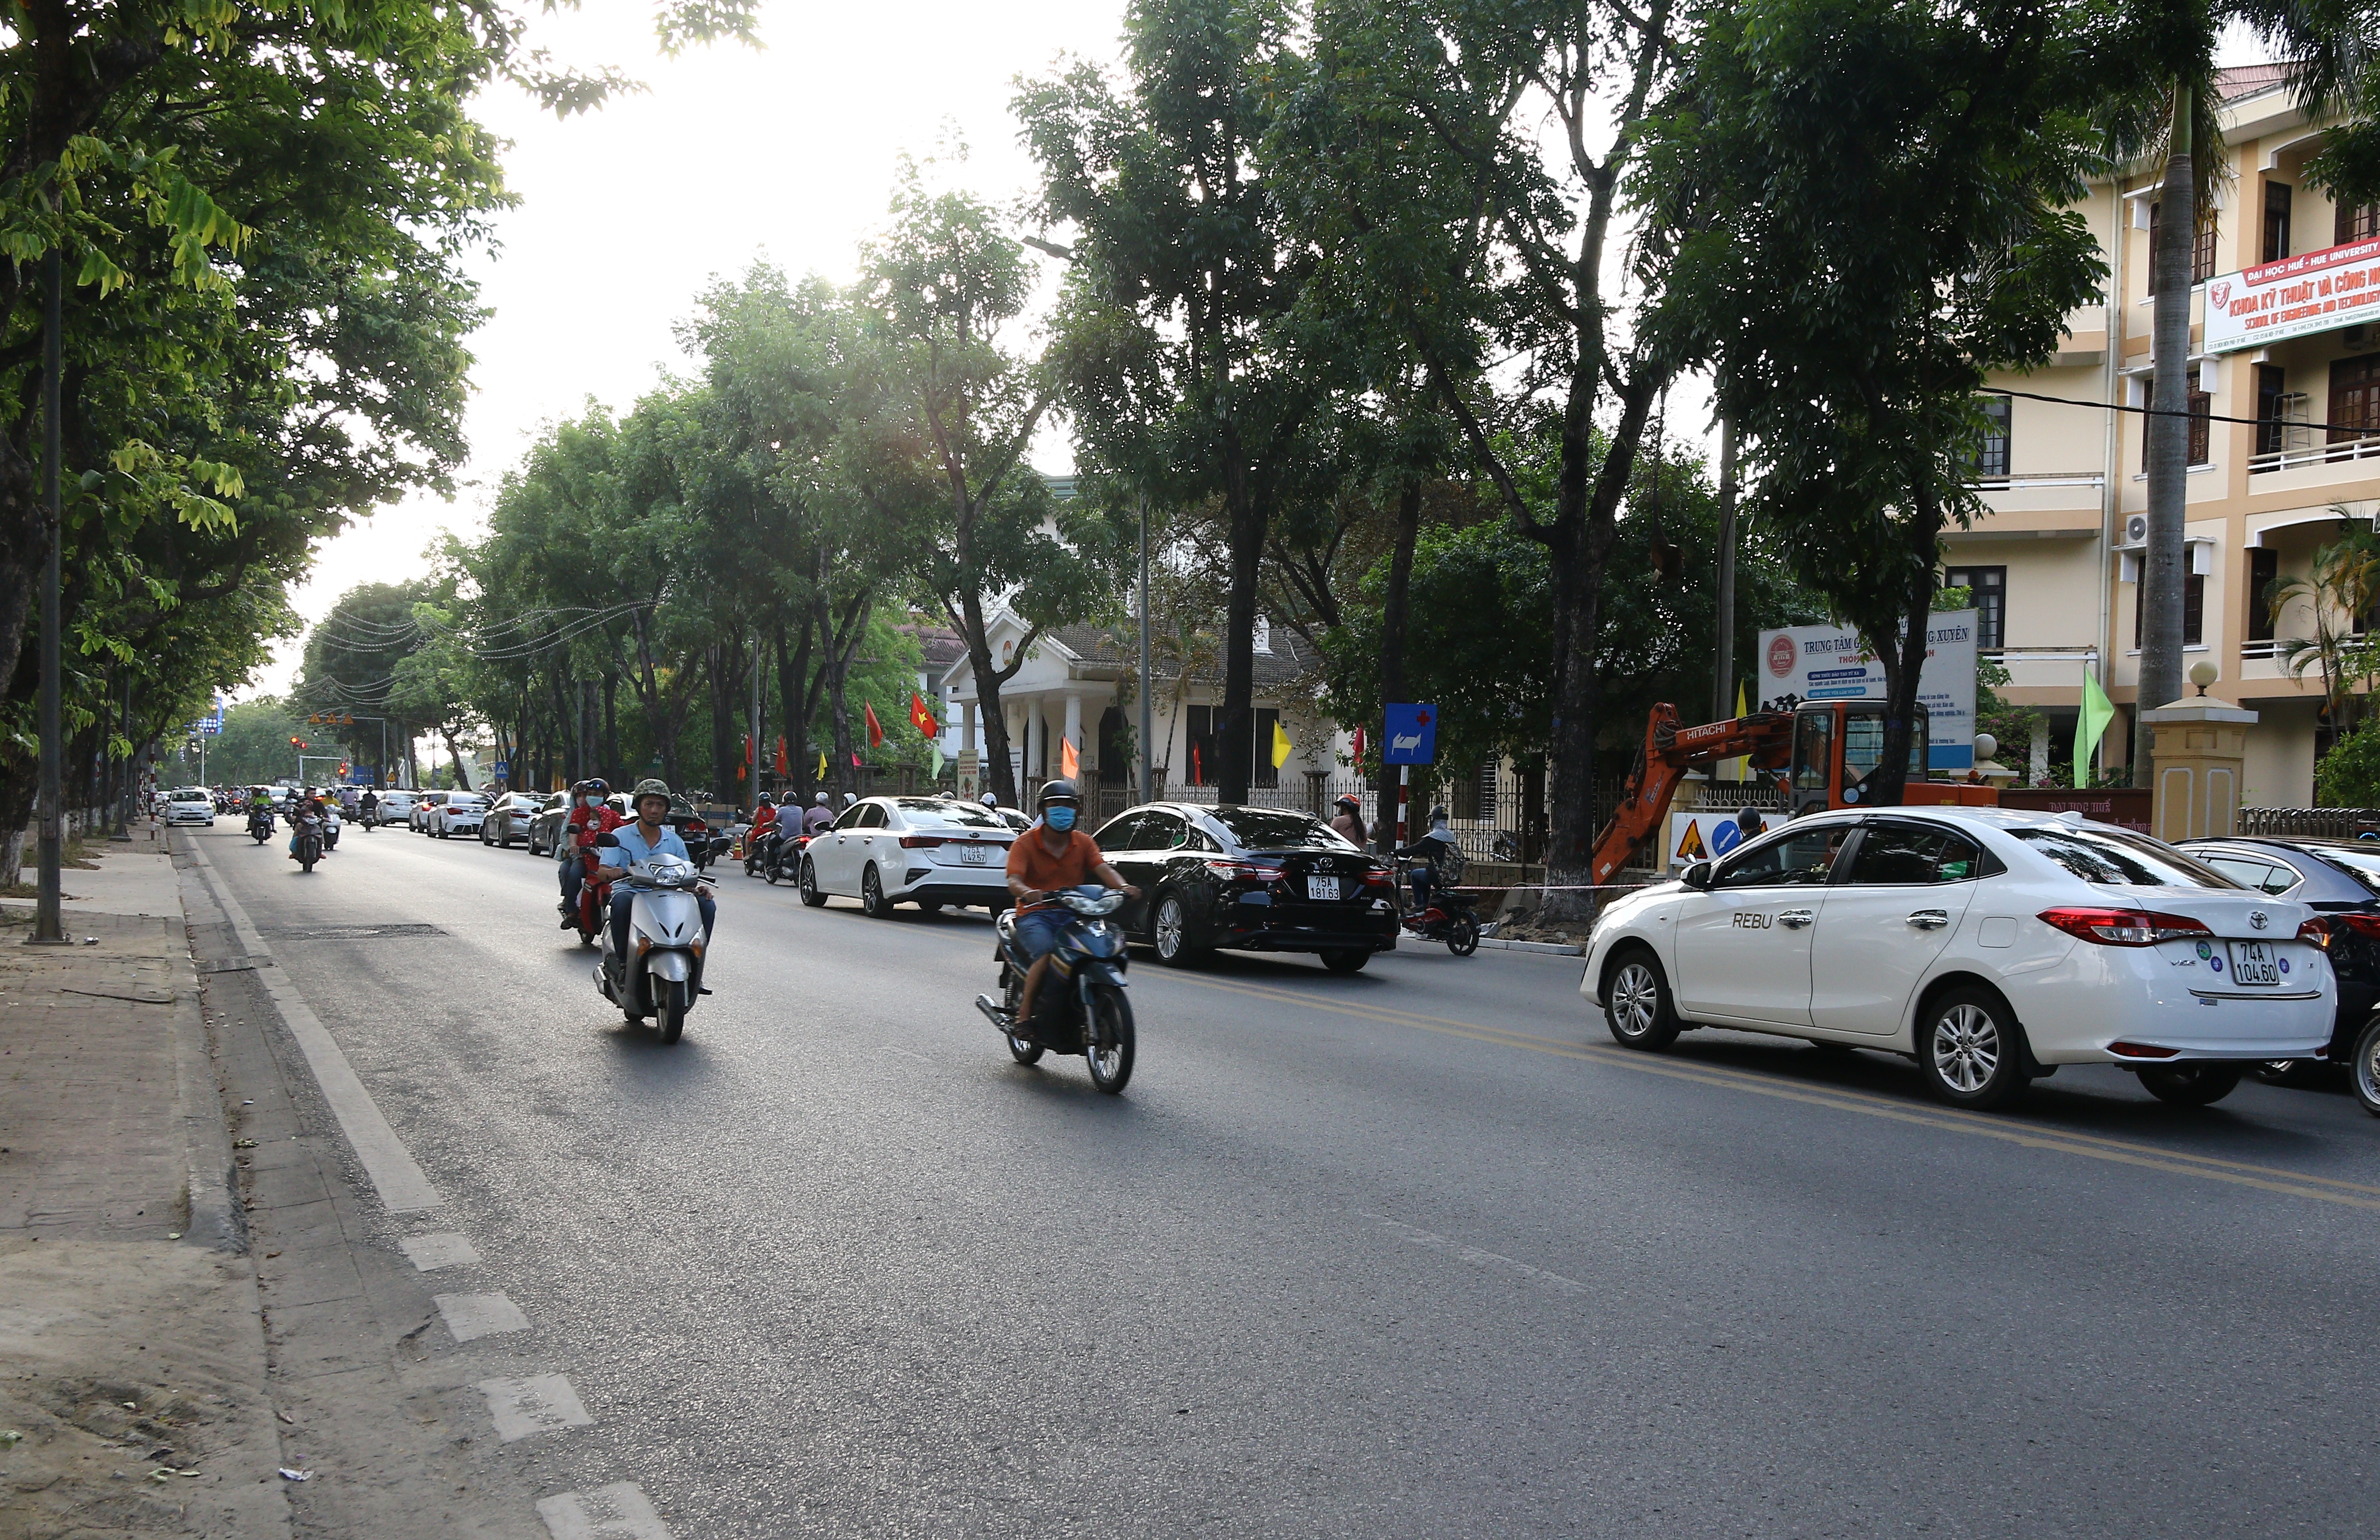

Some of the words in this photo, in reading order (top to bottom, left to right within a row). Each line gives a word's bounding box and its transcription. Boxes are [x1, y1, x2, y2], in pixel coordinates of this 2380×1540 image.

[2247, 271, 2262, 281] ĐẠI
[2265, 265, 2285, 278] HỌC
[2287, 256, 2305, 271] HUẾ
[2311, 254, 2327, 266] HUE
[2330, 242, 2379, 261] UNIVERSITY
[2229, 295, 2258, 317] KHOA
[2261, 288, 2276, 310] KỸ
[2280, 280, 2315, 305] THUẬT
[2317, 275, 2332, 296] VÀ
[2335, 270, 2365, 293] CÔNG
[2245, 314, 2270, 330] SCHOOL
[2271, 312, 2280, 324] OF
[2281, 303, 2321, 323] ENGINEERING
[2322, 300, 2336, 313] AND
[2338, 290, 2380, 310] TECHNOLOGY
[1804, 640, 1832, 653] TRUNG
[1833, 636, 1852, 650] TÂM
[1937, 625, 1968, 642] XUYÊN
[1687, 724, 1726, 740] HITACHI
[2091, 798, 2111, 813] HUẾ
[1316, 877, 1332, 887] 75A
[1311, 888, 1339, 899] 181.63
[1732, 913, 1773, 929] REBU
[2241, 944, 2265, 962] 74A
[2237, 964, 2276, 982] 104.60
